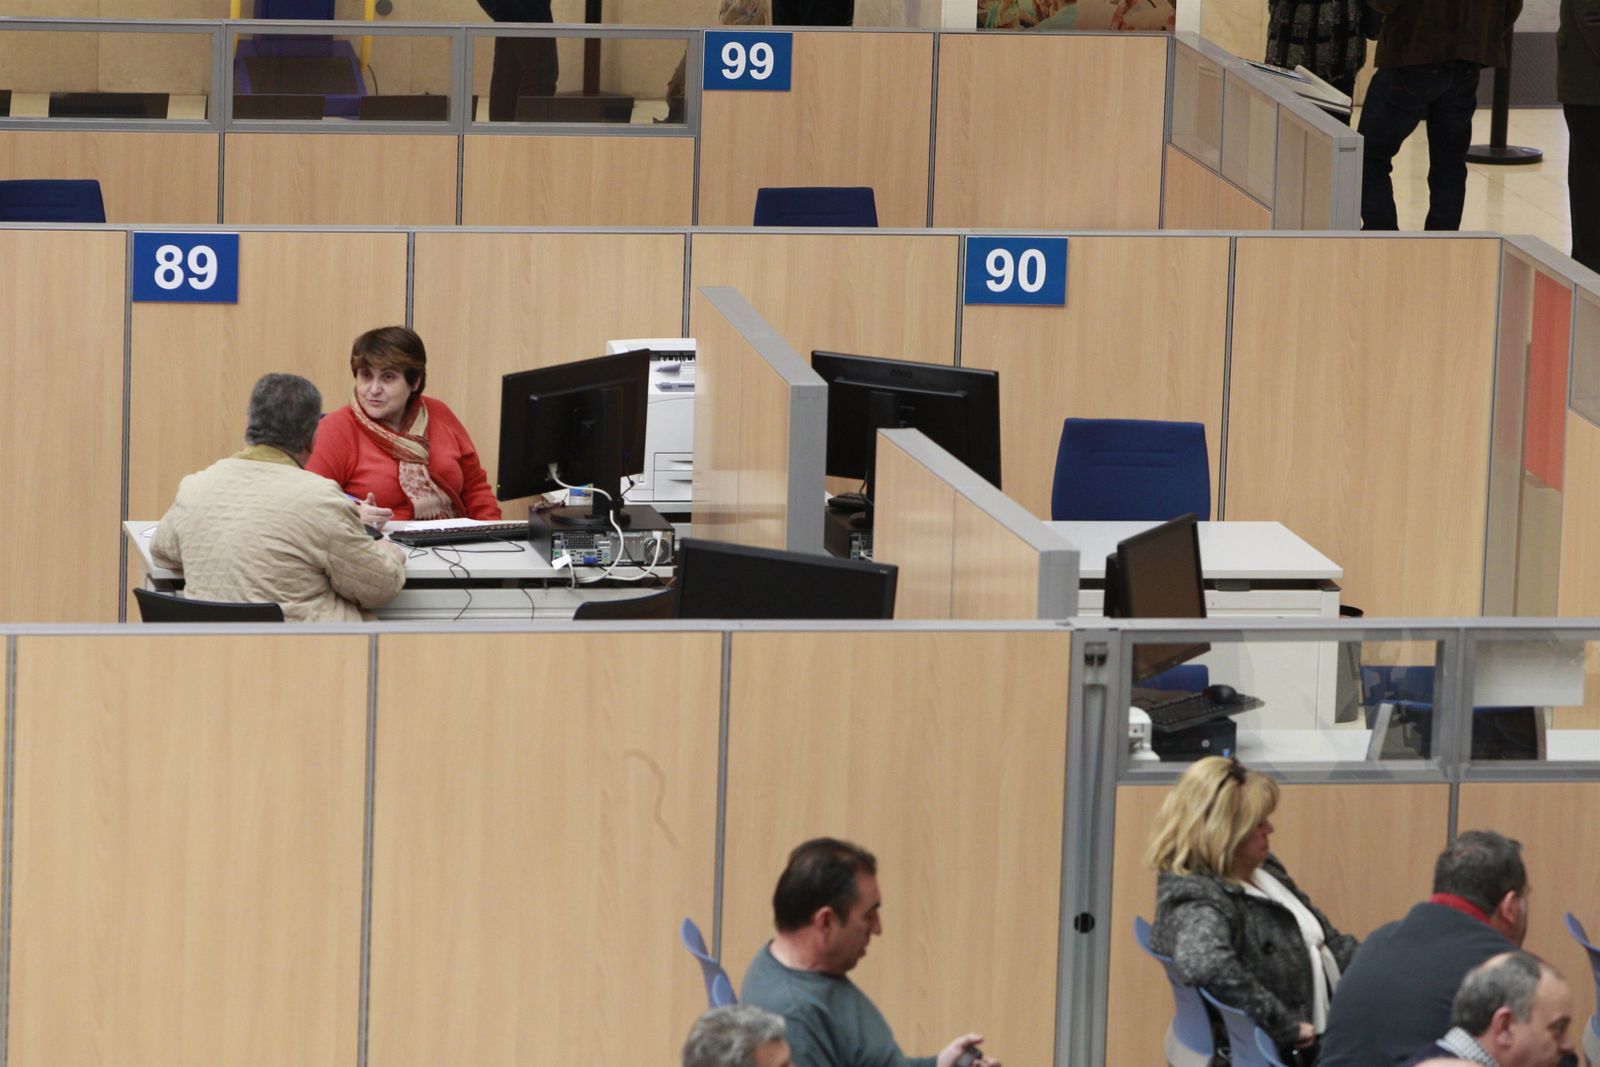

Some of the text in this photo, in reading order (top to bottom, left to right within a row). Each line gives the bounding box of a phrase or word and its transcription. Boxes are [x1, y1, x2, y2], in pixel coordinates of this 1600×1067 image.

[721, 41, 774, 80] 99
[154, 244, 218, 290] 89
[985, 248, 1046, 293] 90
